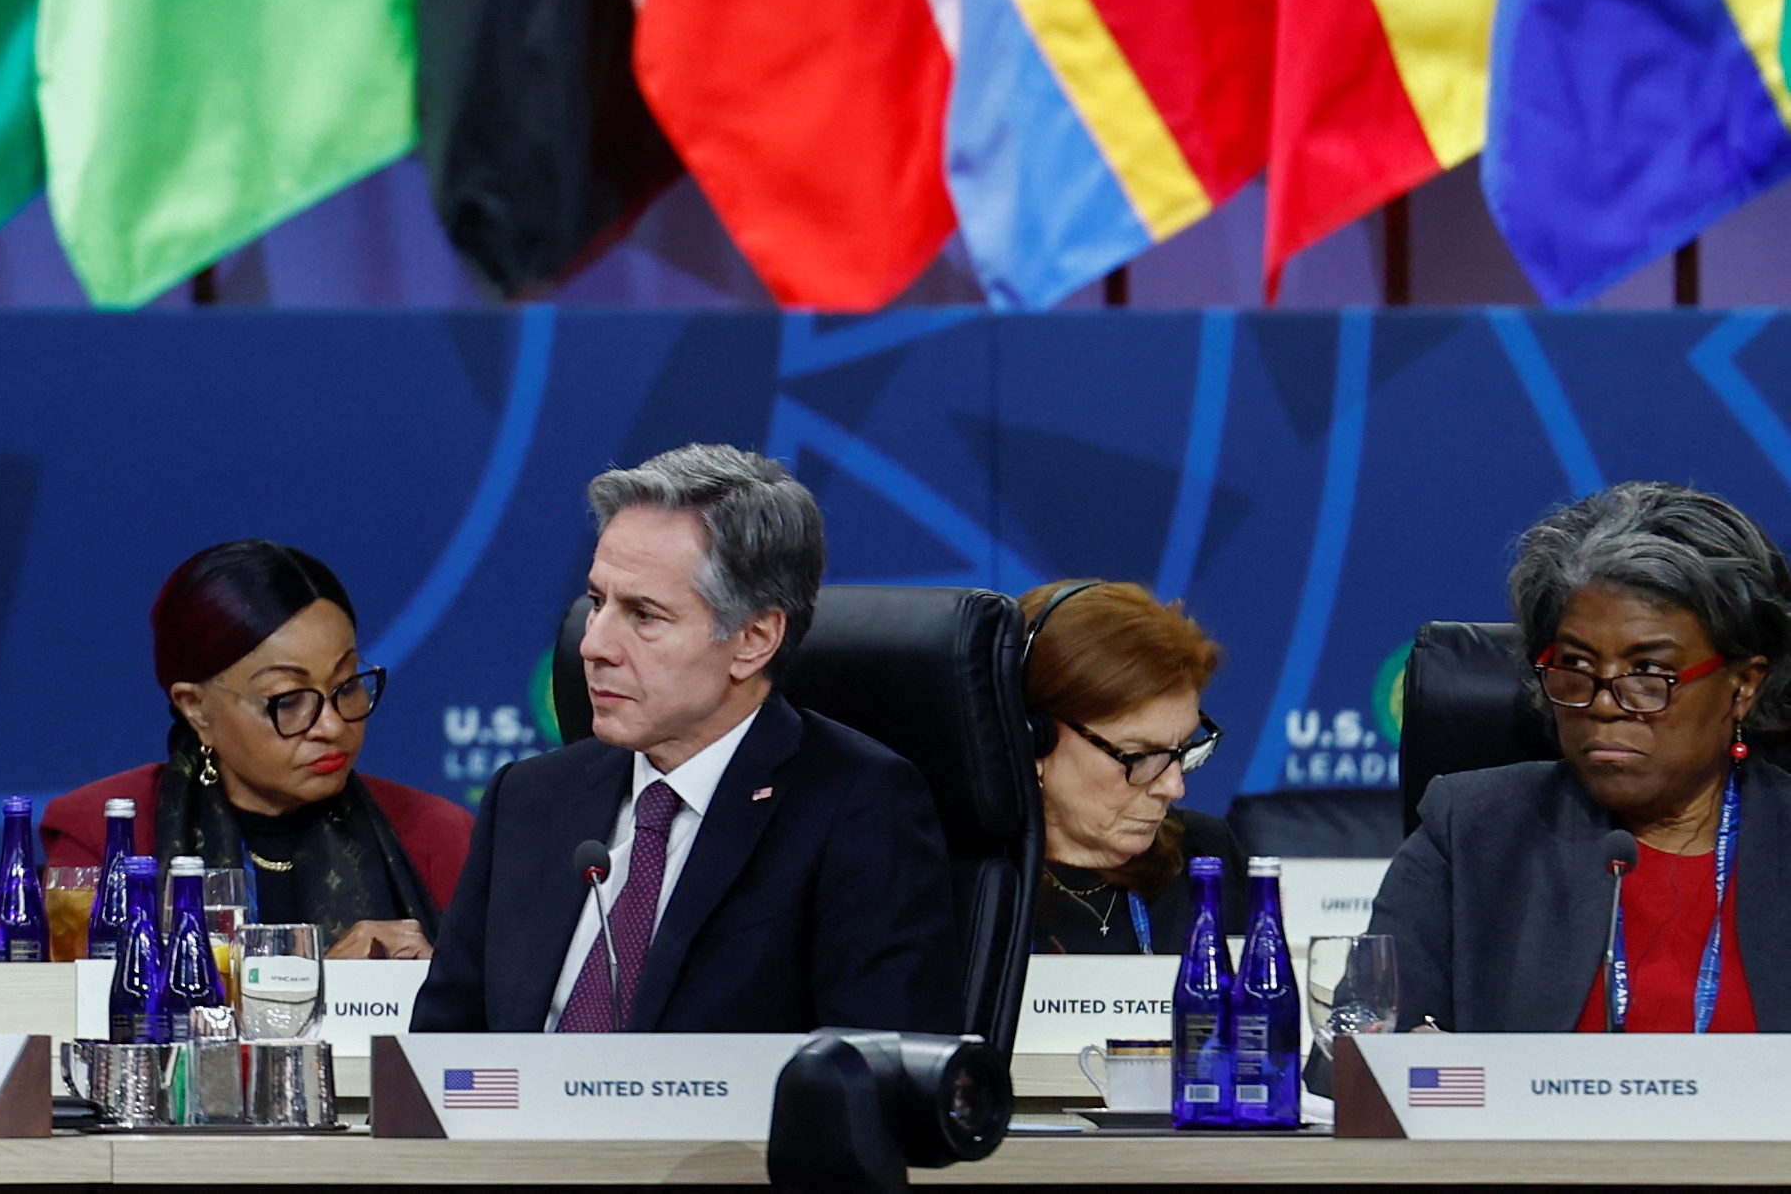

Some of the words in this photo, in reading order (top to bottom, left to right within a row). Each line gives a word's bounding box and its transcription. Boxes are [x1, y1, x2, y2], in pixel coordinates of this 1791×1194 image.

[444, 706, 535, 744] U.S.
[1286, 709, 1377, 748] U.S.
[335, 1001, 399, 1016] UNION
[1032, 999, 1107, 1015] UNITED
[1112, 999, 1172, 1015] STATE
[564, 1080, 645, 1097] UNITED
[651, 1080, 729, 1097] STATES
[1531, 1079, 1613, 1096] UNITED
[1619, 1079, 1699, 1096] STATES
